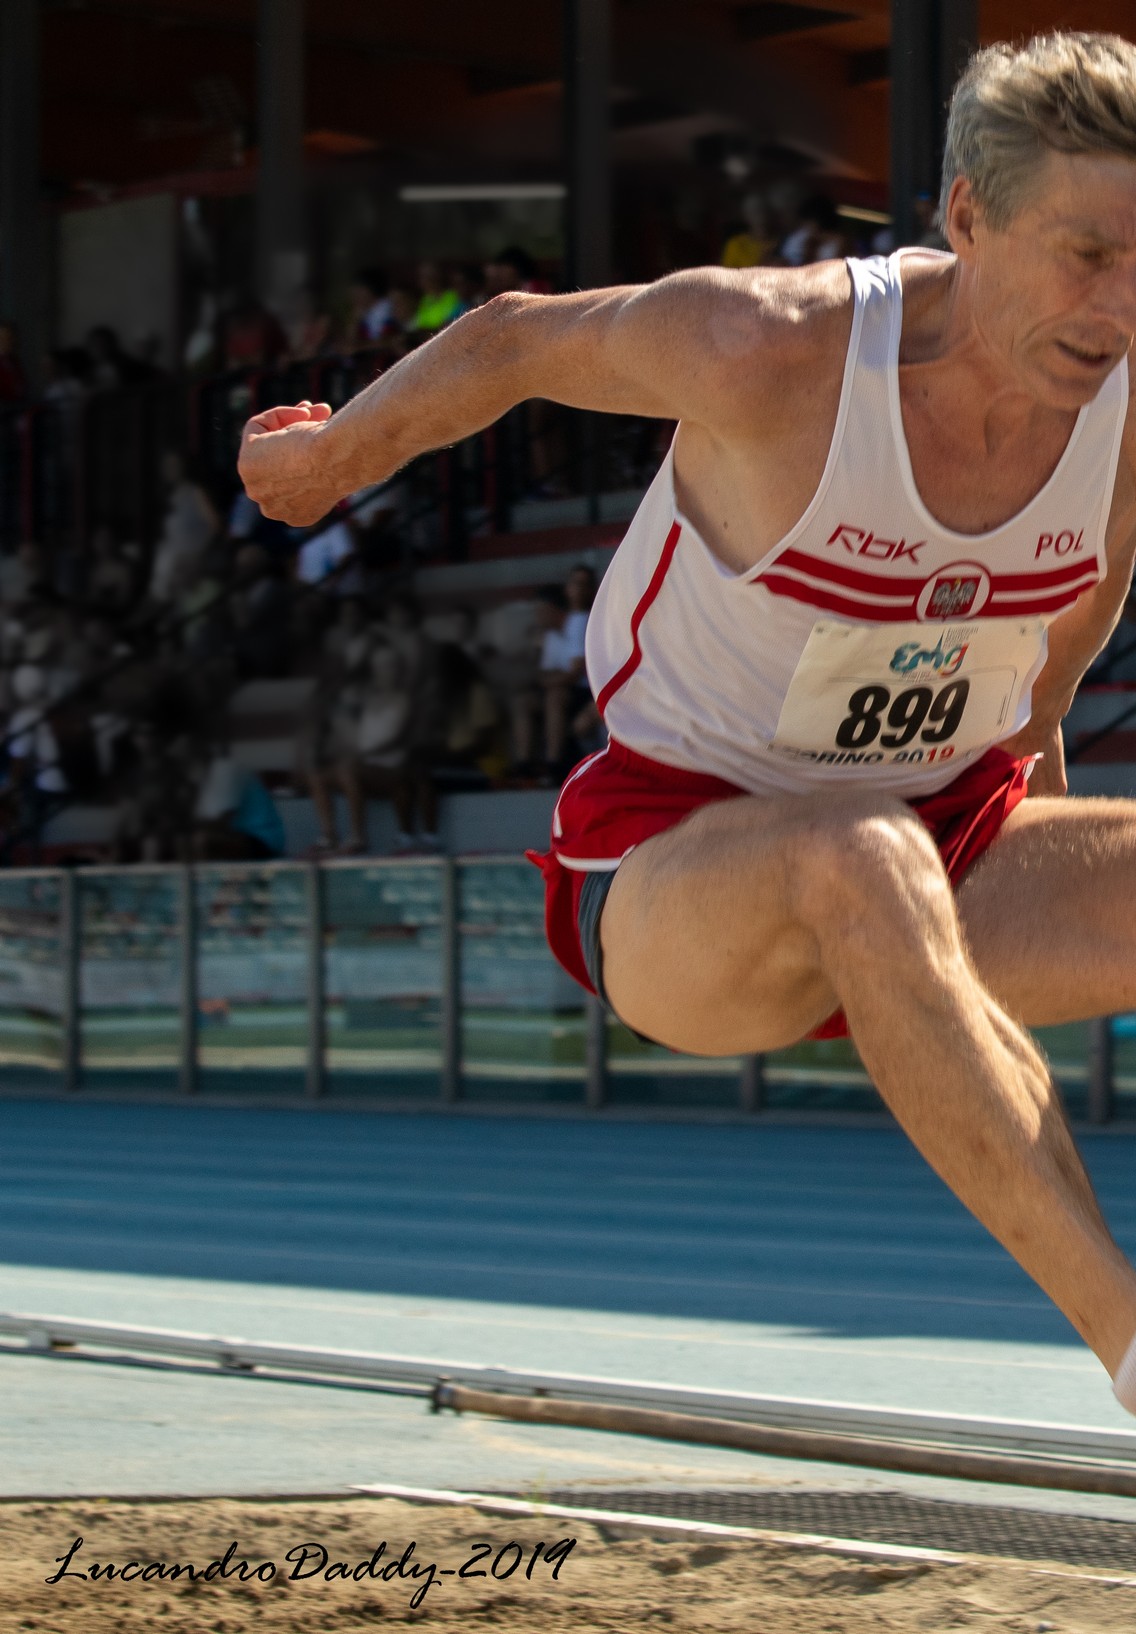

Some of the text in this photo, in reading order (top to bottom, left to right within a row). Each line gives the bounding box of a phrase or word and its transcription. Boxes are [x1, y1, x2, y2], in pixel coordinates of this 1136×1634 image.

[1034, 528, 1084, 560] POL
[835, 678, 970, 749] 899
[888, 745, 956, 764] 2019
